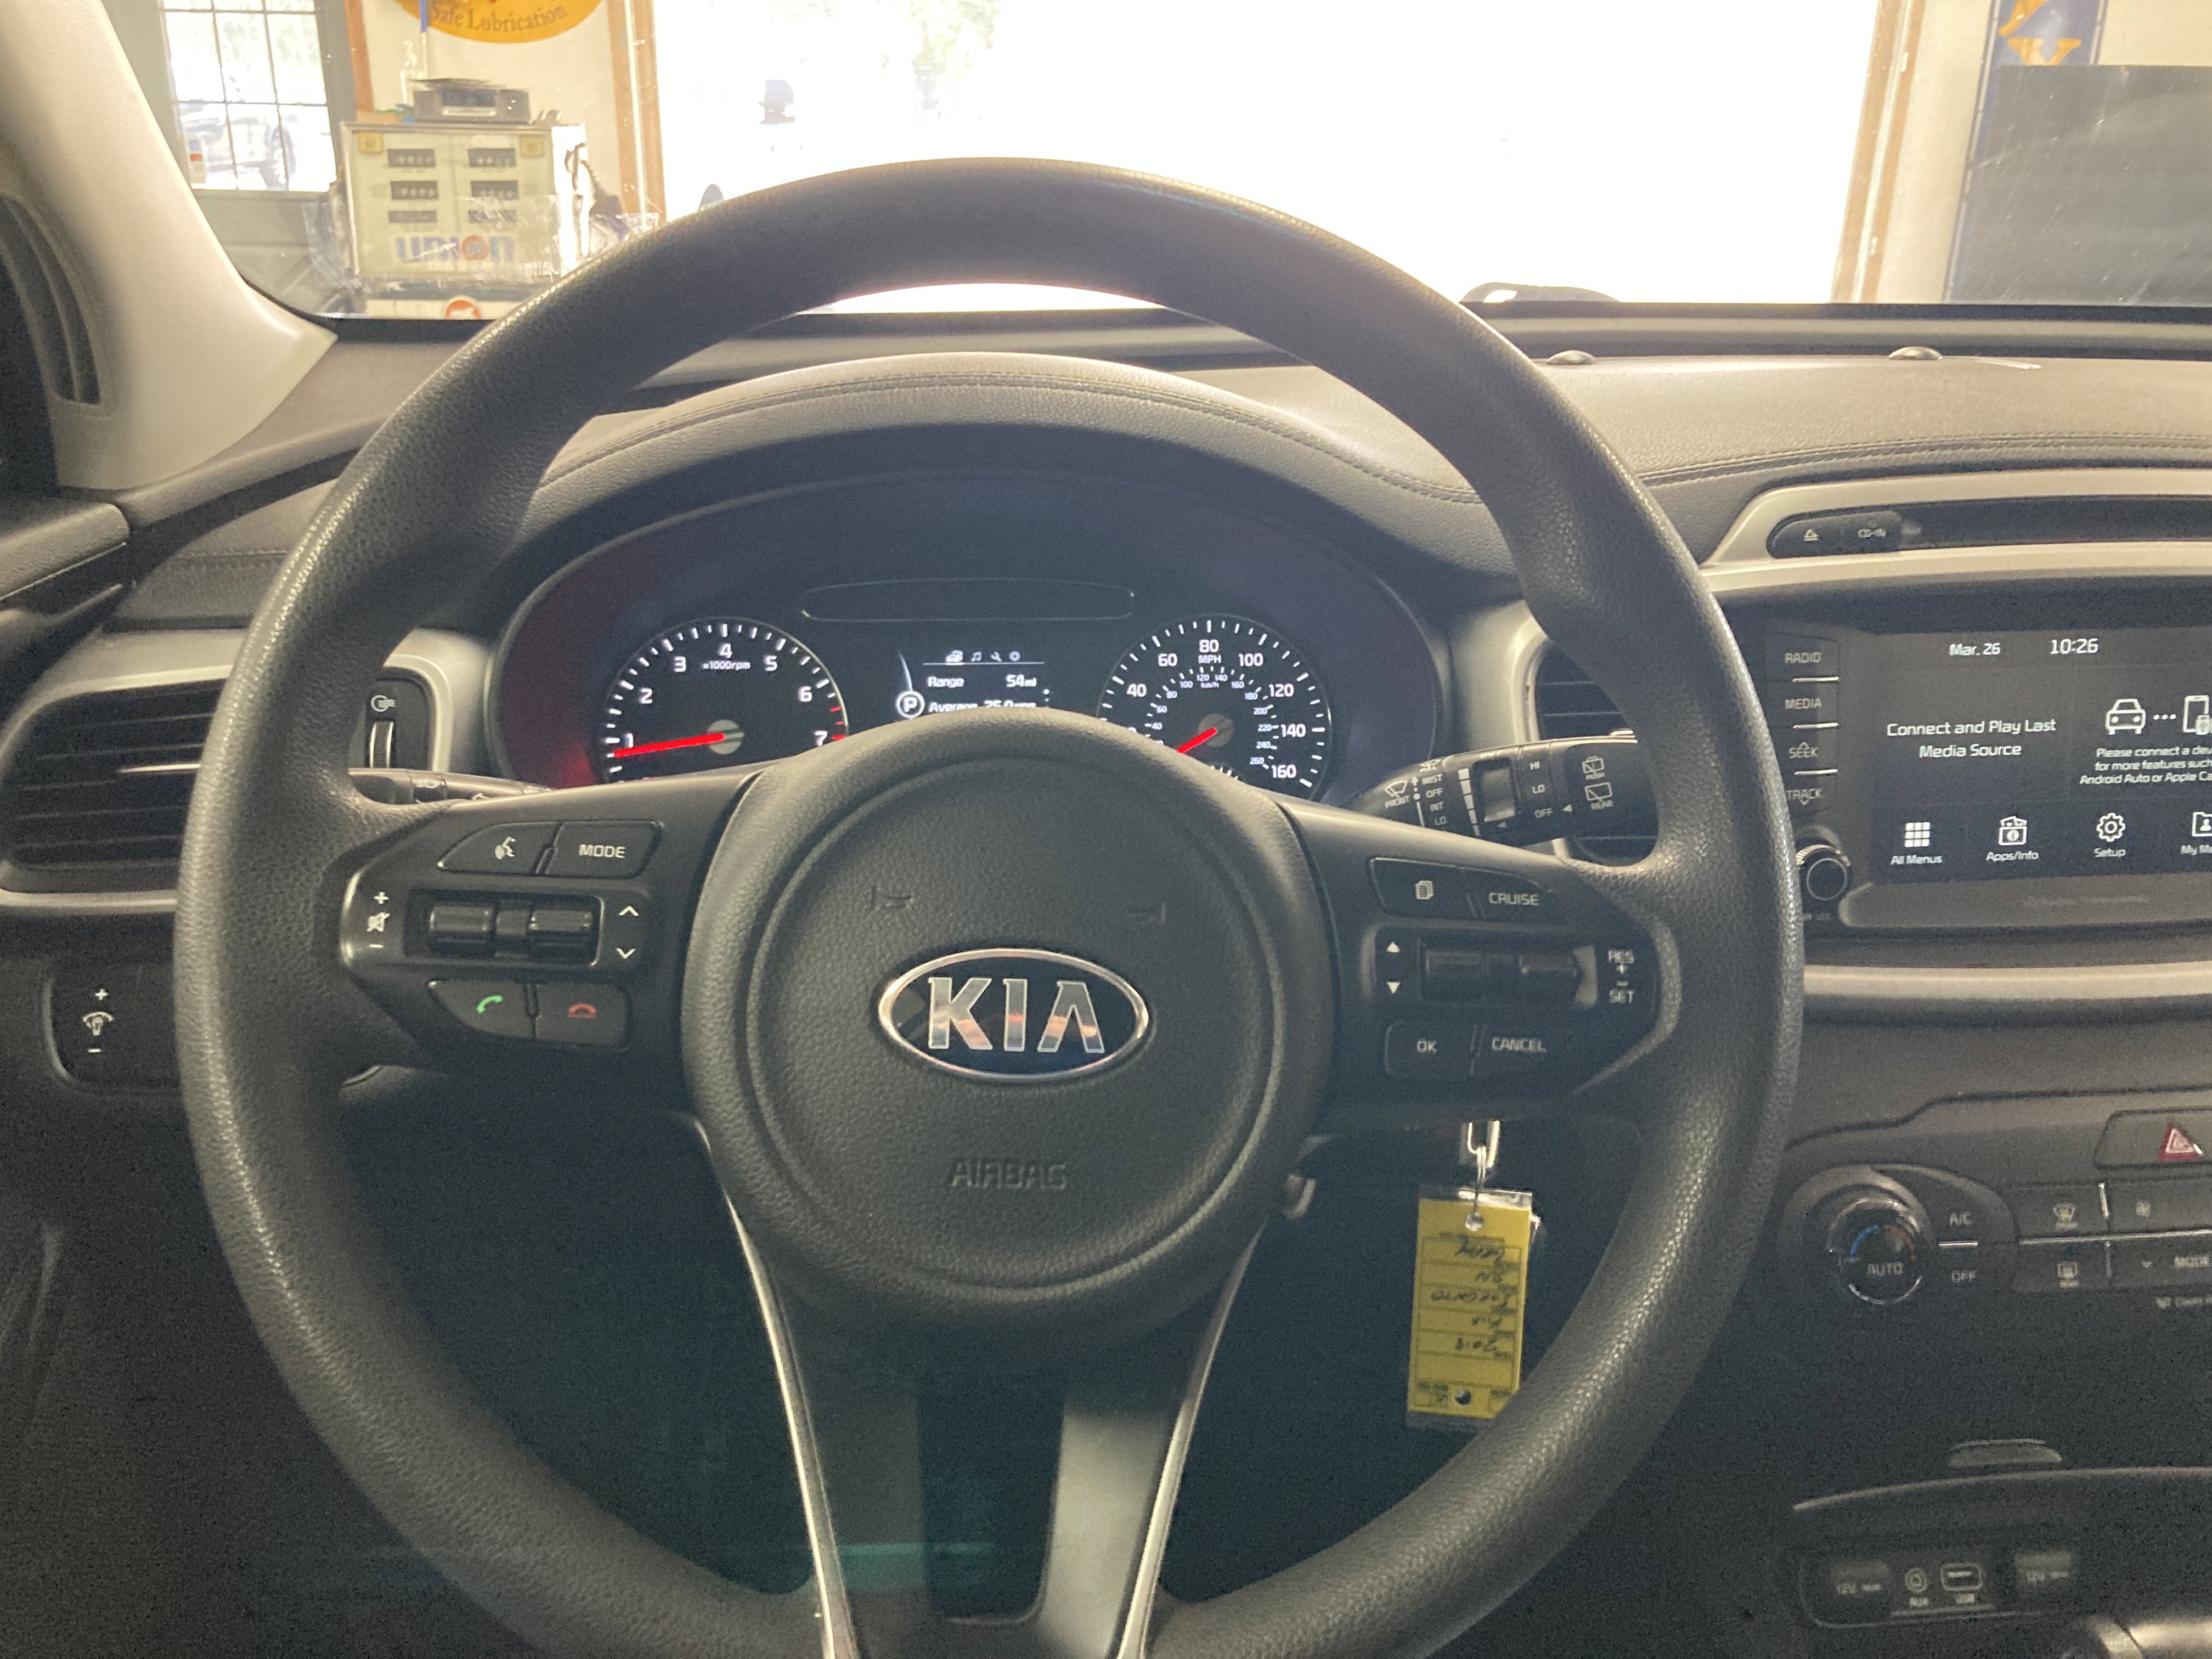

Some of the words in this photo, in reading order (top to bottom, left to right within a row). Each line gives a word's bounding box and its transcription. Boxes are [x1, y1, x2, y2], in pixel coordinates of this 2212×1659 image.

[468, 5, 567, 32] Lubrication
[719, 642, 732, 659] 4
[1199, 639, 1219, 653] 80
[1949, 643, 1980, 656] Mar.
[1983, 642, 2001, 656] 26
[2050, 637, 2099, 656] 10:26
[674, 656, 687, 673] 3
[702, 659, 751, 671] x1000rpm
[765, 655, 778, 672] 5
[1158, 653, 1178, 667] 60
[1198, 654, 1222, 664] MPH
[1238, 653, 1264, 667] 100
[1784, 652, 1822, 664] RADIO
[927, 676, 964, 689] Range
[1180, 680, 1193, 689] 100
[1197, 674, 1210, 682] 120
[1215, 674, 1228, 682] 140
[639, 687, 653, 704] 2
[799, 686, 812, 702] 6
[1127, 683, 1147, 698] 40
[1268, 683, 1295, 698] 120
[1785, 697, 1822, 709] MEDIA
[1152, 722, 1163, 730] 40
[1280, 723, 1307, 738] 140
[1886, 721, 1951, 736] Connect
[1954, 720, 1985, 734] and
[1988, 720, 2021, 735] Play
[2024, 719, 2057, 732] Last
[624, 732, 634, 748] 1
[814, 730, 828, 746] 7
[1789, 747, 1819, 758] SEEK
[1918, 744, 1967, 758] Media
[1970, 743, 2022, 757] Source
[2096, 748, 2133, 758] Please
[2134, 746, 2180, 757] connect
[2181, 747, 2190, 755] a
[1271, 764, 1296, 779] 160
[1530, 761, 1541, 770] HI
[2095, 761, 2111, 771] for
[2111, 761, 2140, 770] more
[2141, 760, 2186, 770] features
[1421, 773, 1443, 785] MIST
[2079, 774, 2123, 785] Android
[2123, 773, 2151, 783] Auto
[2151, 774, 2164, 783] or
[2164, 772, 2197, 783] Apple
[1426, 787, 1443, 799] OFF
[1532, 784, 1545, 794] LO
[1786, 788, 1822, 801] TRACK
[1591, 800, 1613, 811] REAR
[1534, 808, 1554, 819] OFF
[1435, 816, 1447, 826] LO
[579, 844, 625, 859] MODE
[1985, 850, 2039, 862] Apps/Info
[2094, 848, 2126, 858] Setup
[1906, 854, 1943, 865] Menus
[1488, 892, 1540, 907] CRUISE
[1607, 949, 1635, 964] RES
[1609, 989, 1635, 1005] SET
[928, 977, 1105, 1053] KIA
[1417, 1039, 1438, 1054] OK
[1491, 1037, 1547, 1053] CANCEL
[951, 1159, 1068, 1190] AIRBAG
[1949, 1211, 1974, 1226] A/C
[1867, 1262, 1904, 1277] AUTO
[1951, 1270, 1977, 1283] OFF
